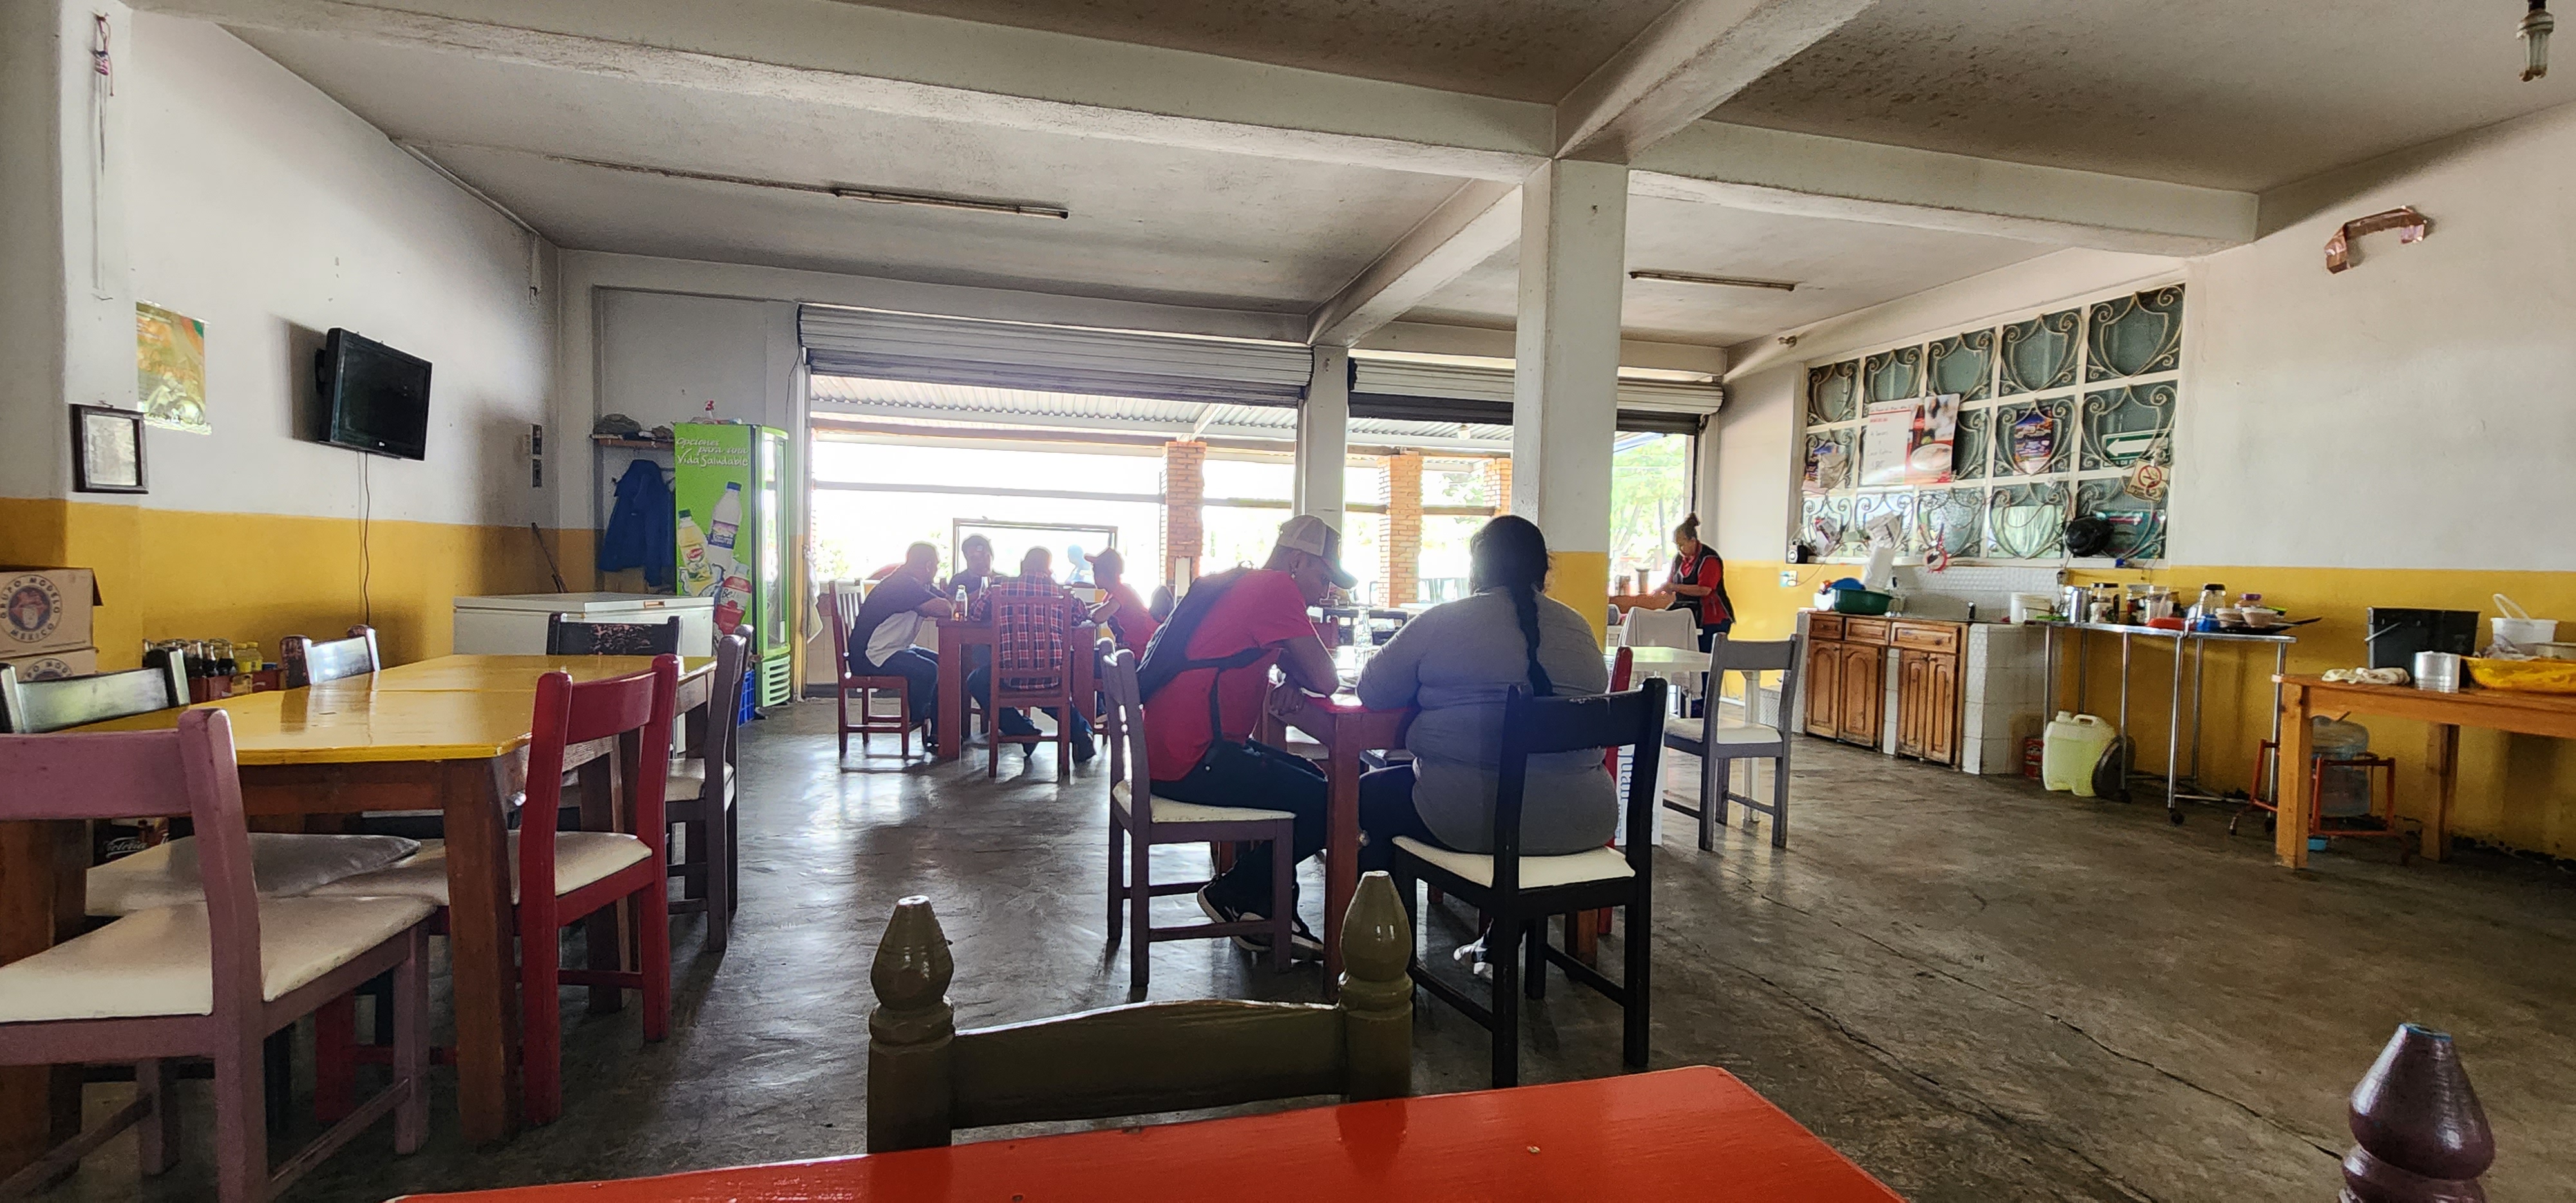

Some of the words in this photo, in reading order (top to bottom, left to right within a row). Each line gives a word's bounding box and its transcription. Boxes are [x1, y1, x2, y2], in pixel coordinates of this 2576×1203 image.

[677, 448, 699, 464] Vida
[700, 455, 749, 468] Saludable
[30, 577, 61, 614] MODELO
